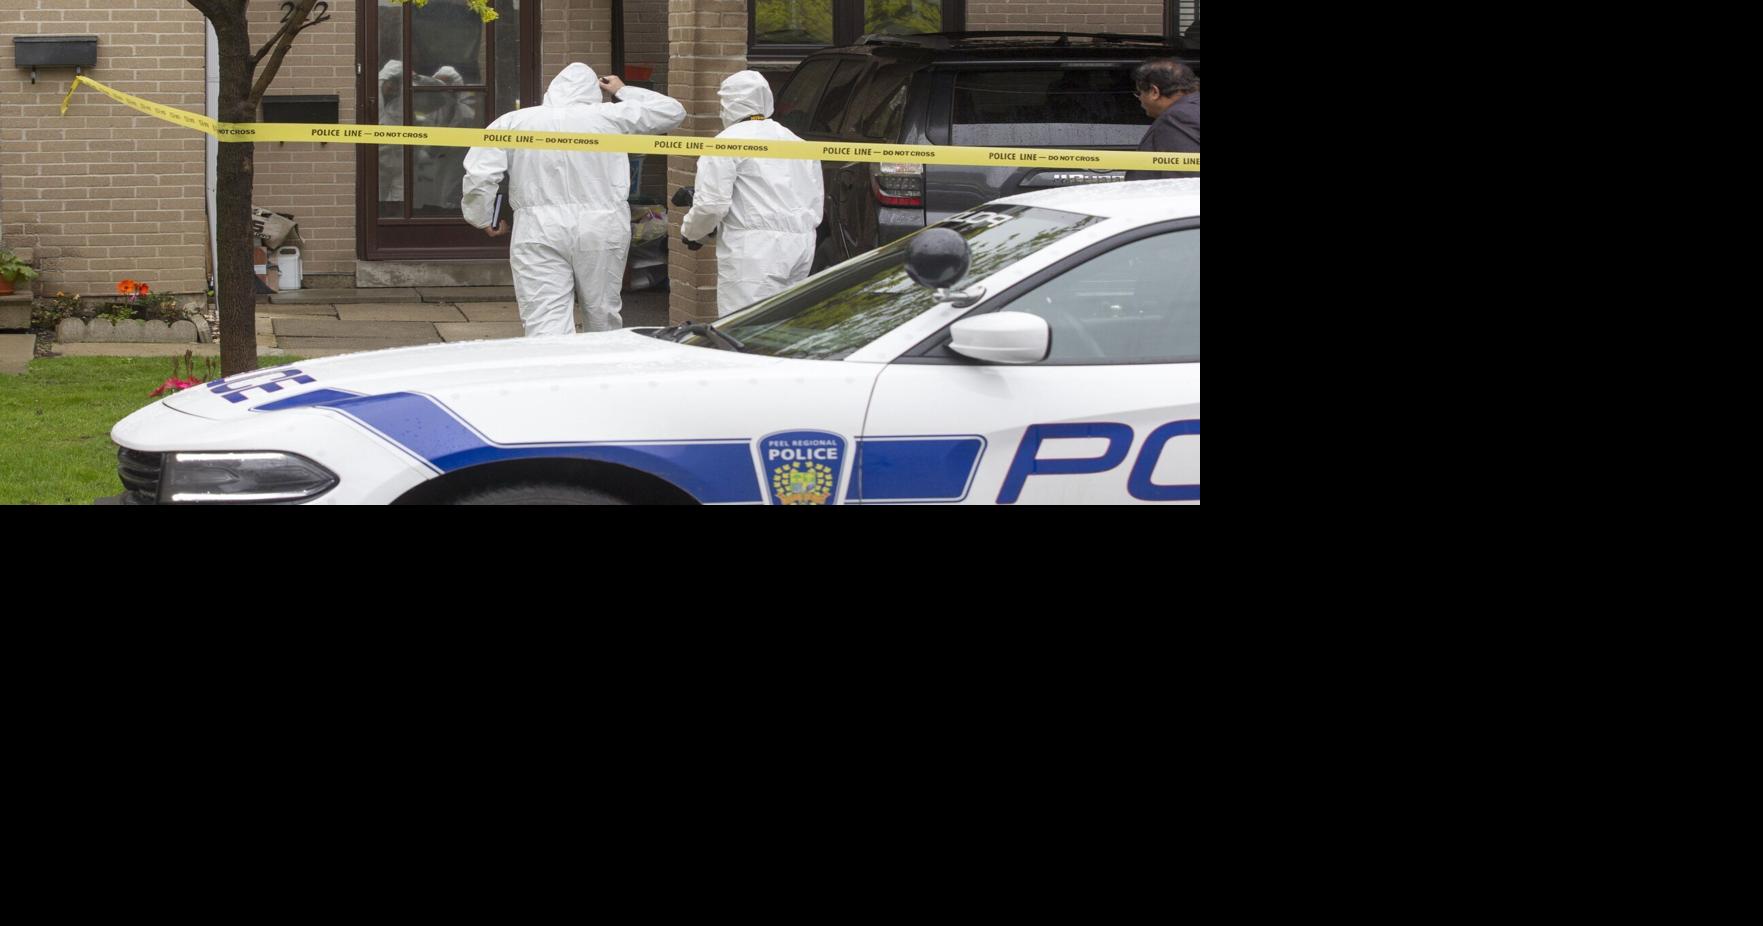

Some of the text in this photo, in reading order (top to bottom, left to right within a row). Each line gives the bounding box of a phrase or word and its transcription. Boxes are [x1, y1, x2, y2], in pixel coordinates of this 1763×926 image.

[311, 129, 340, 137] POLICE
[344, 129, 362, 137] LINE
[483, 134, 512, 142] POLICE
[516, 135, 534, 143] LINE
[654, 141, 682, 149] POLICE
[686, 142, 704, 150] LINE
[823, 147, 850, 155] POLICE
[854, 148, 871, 156] LINE
[989, 152, 1016, 160] POLICE
[1020, 153, 1037, 161] LINE
[1153, 157, 1179, 165] POLICE
[792, 439, 838, 447] REGIONAL
[768, 447, 838, 461] POLICE
